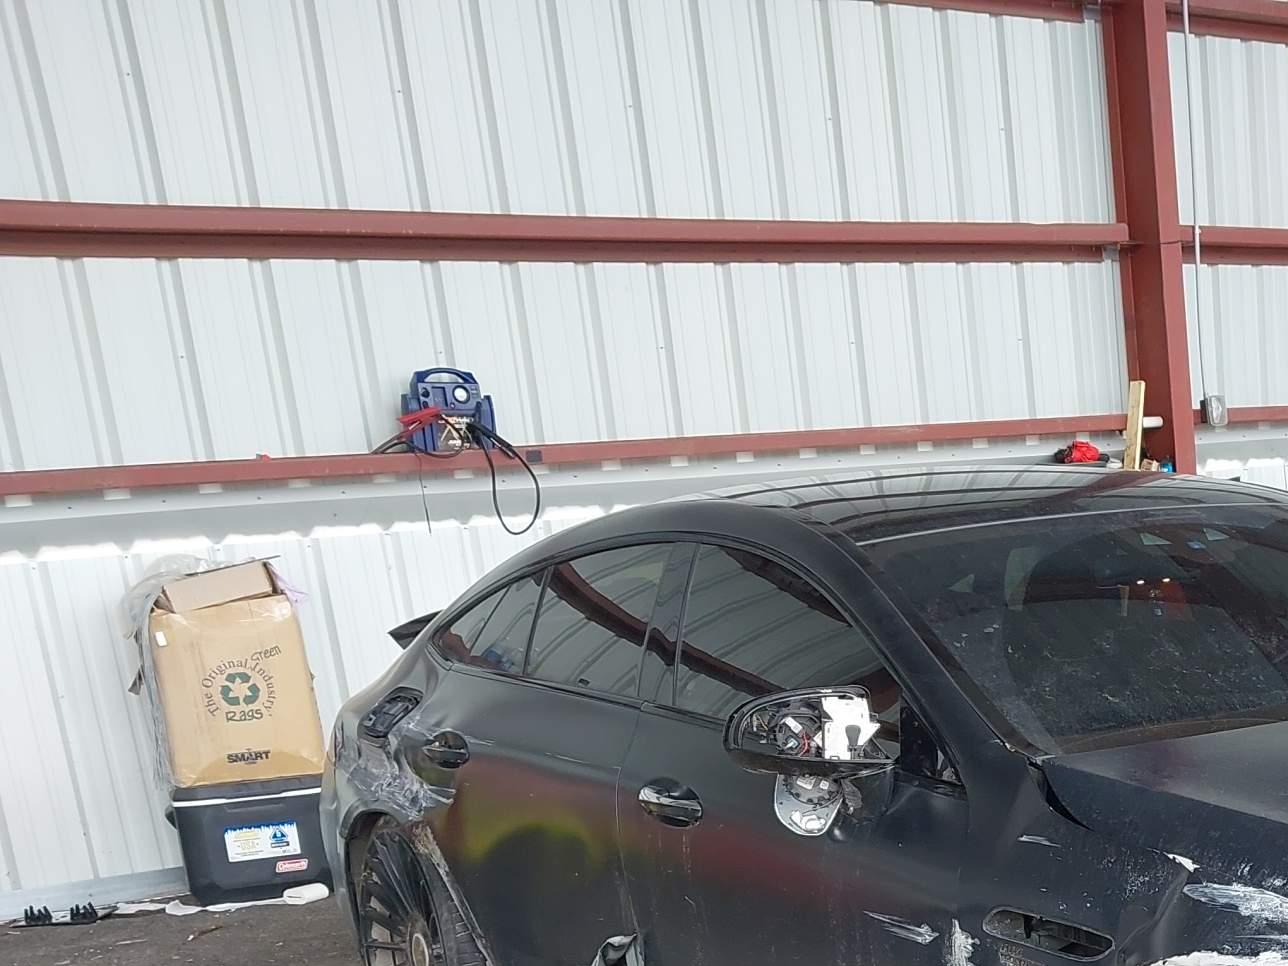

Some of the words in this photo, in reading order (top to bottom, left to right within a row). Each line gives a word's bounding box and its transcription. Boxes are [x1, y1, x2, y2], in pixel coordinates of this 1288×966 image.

[250, 645, 282, 662] Green
[201, 658, 249, 689] Original
[204, 692, 220, 717] The
[225, 708, 264, 723] Rags
[226, 749, 271, 763] SMART
